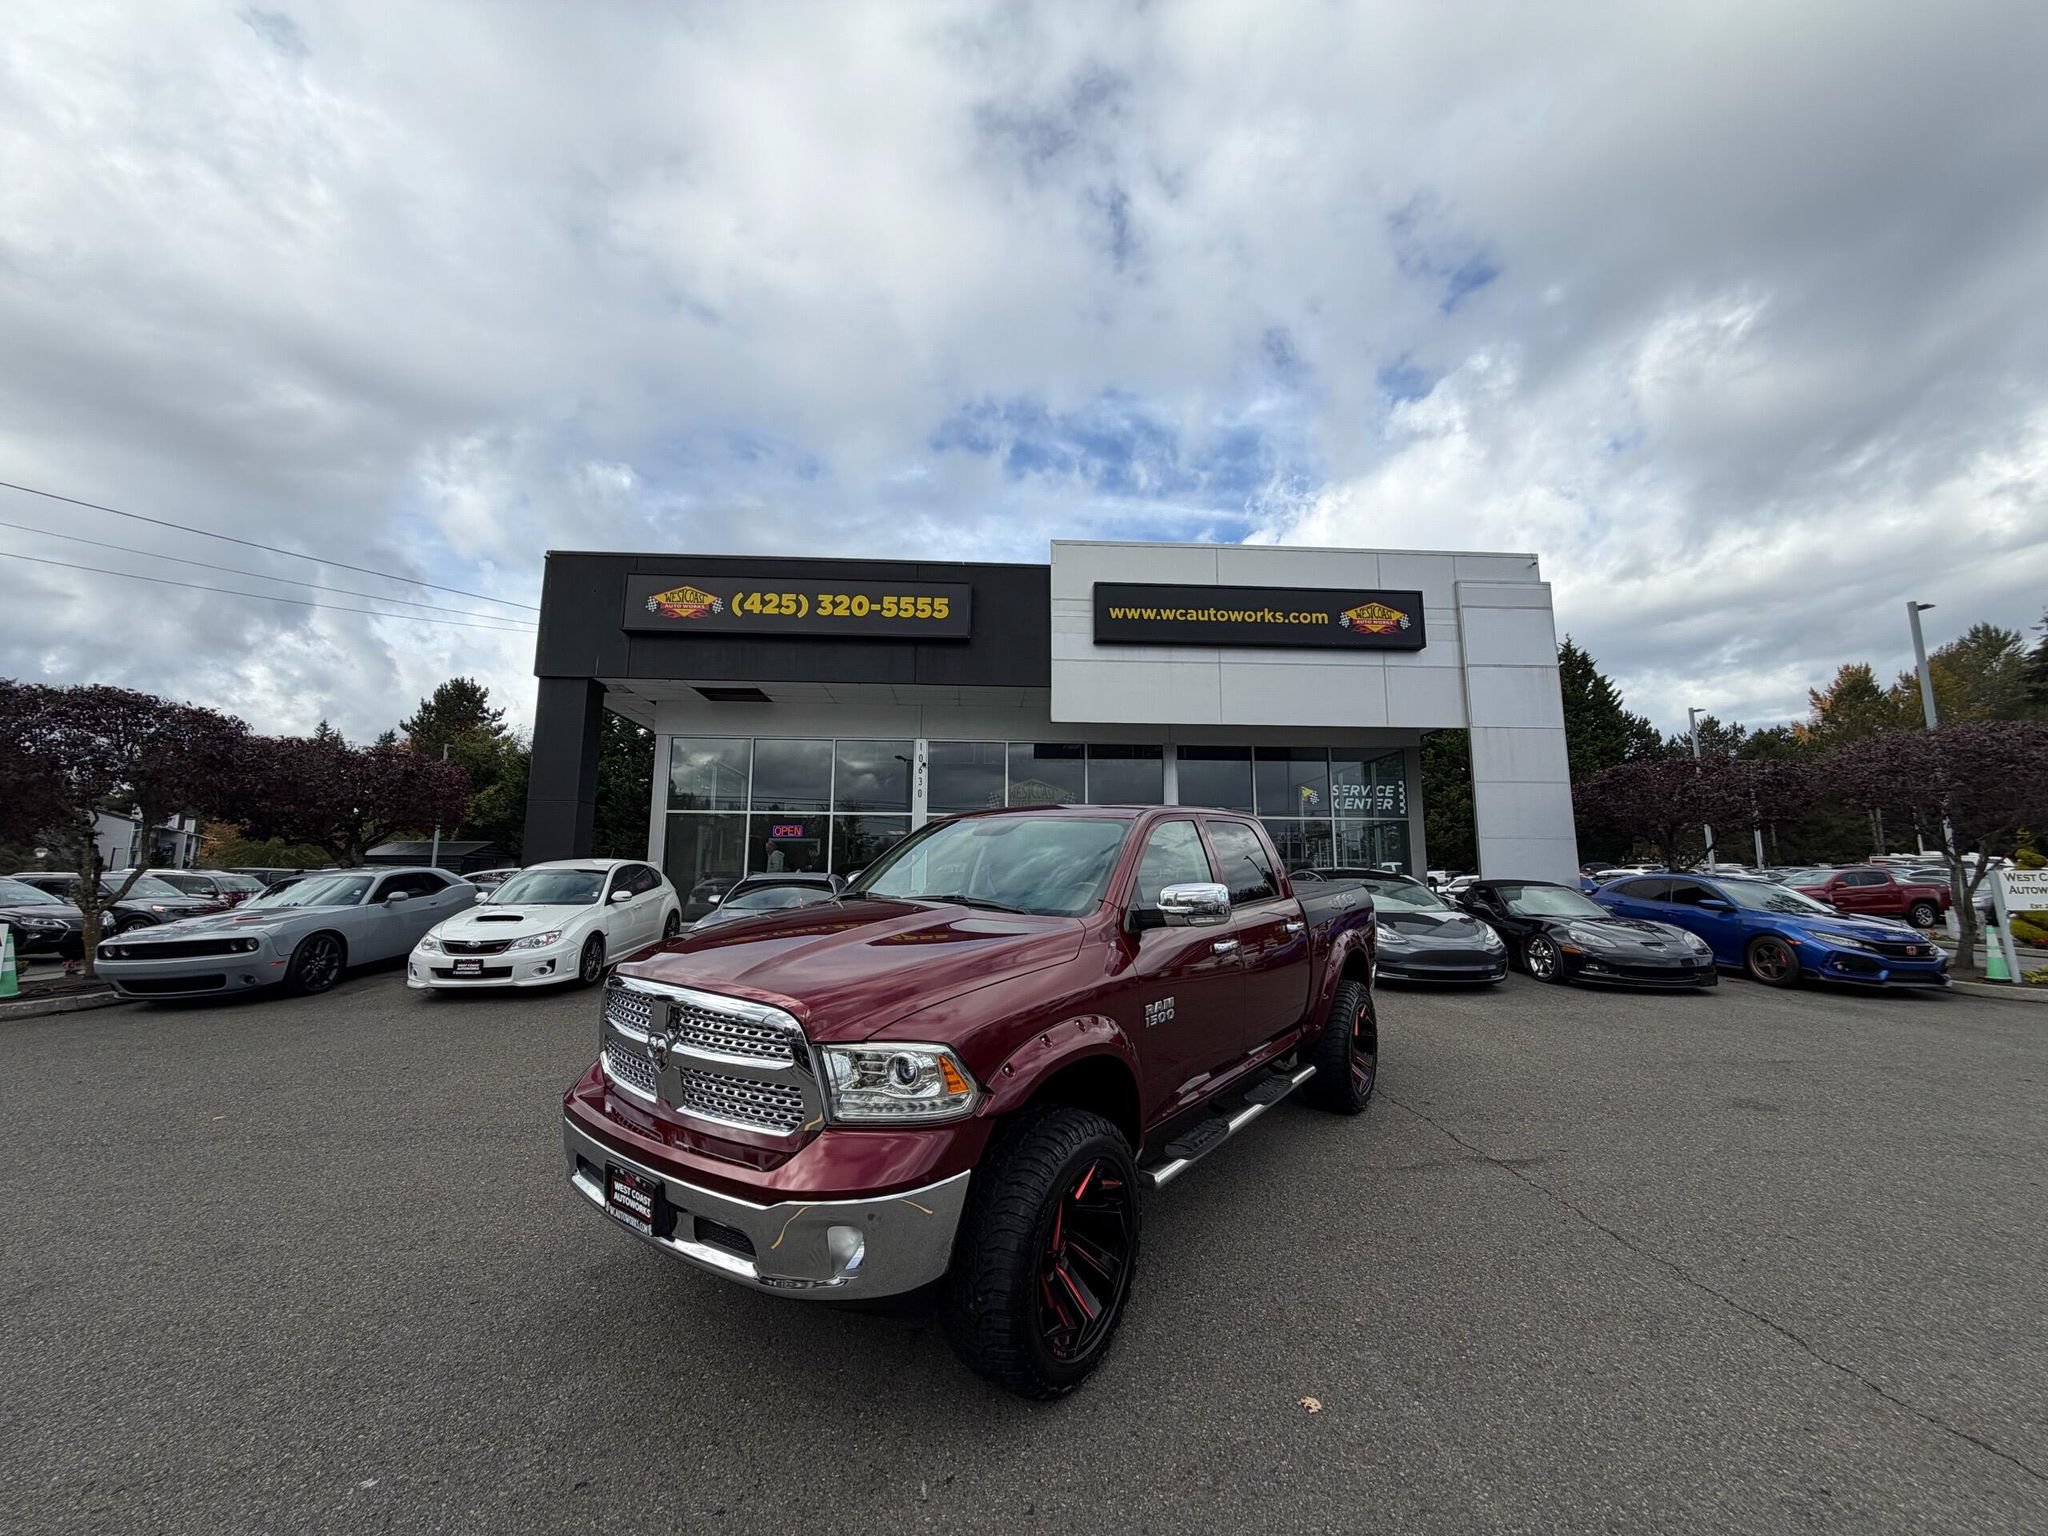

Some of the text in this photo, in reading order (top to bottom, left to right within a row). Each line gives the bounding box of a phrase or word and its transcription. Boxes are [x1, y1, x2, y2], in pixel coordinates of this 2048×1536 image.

[731, 592, 949, 619] (425) 320-5555
[1109, 606, 1329, 624] www.wcautoworks.com
[1332, 785, 1395, 797] SERVCE
[774, 826, 801, 836] OPEN
[2003, 872, 2037, 882] WEST
[1145, 996, 1175, 1016] RAM
[1145, 1008, 1175, 1028] 1500
[613, 1180, 652, 1207] WEST COAST
[613, 1191, 651, 1218] AUTOWORKS
